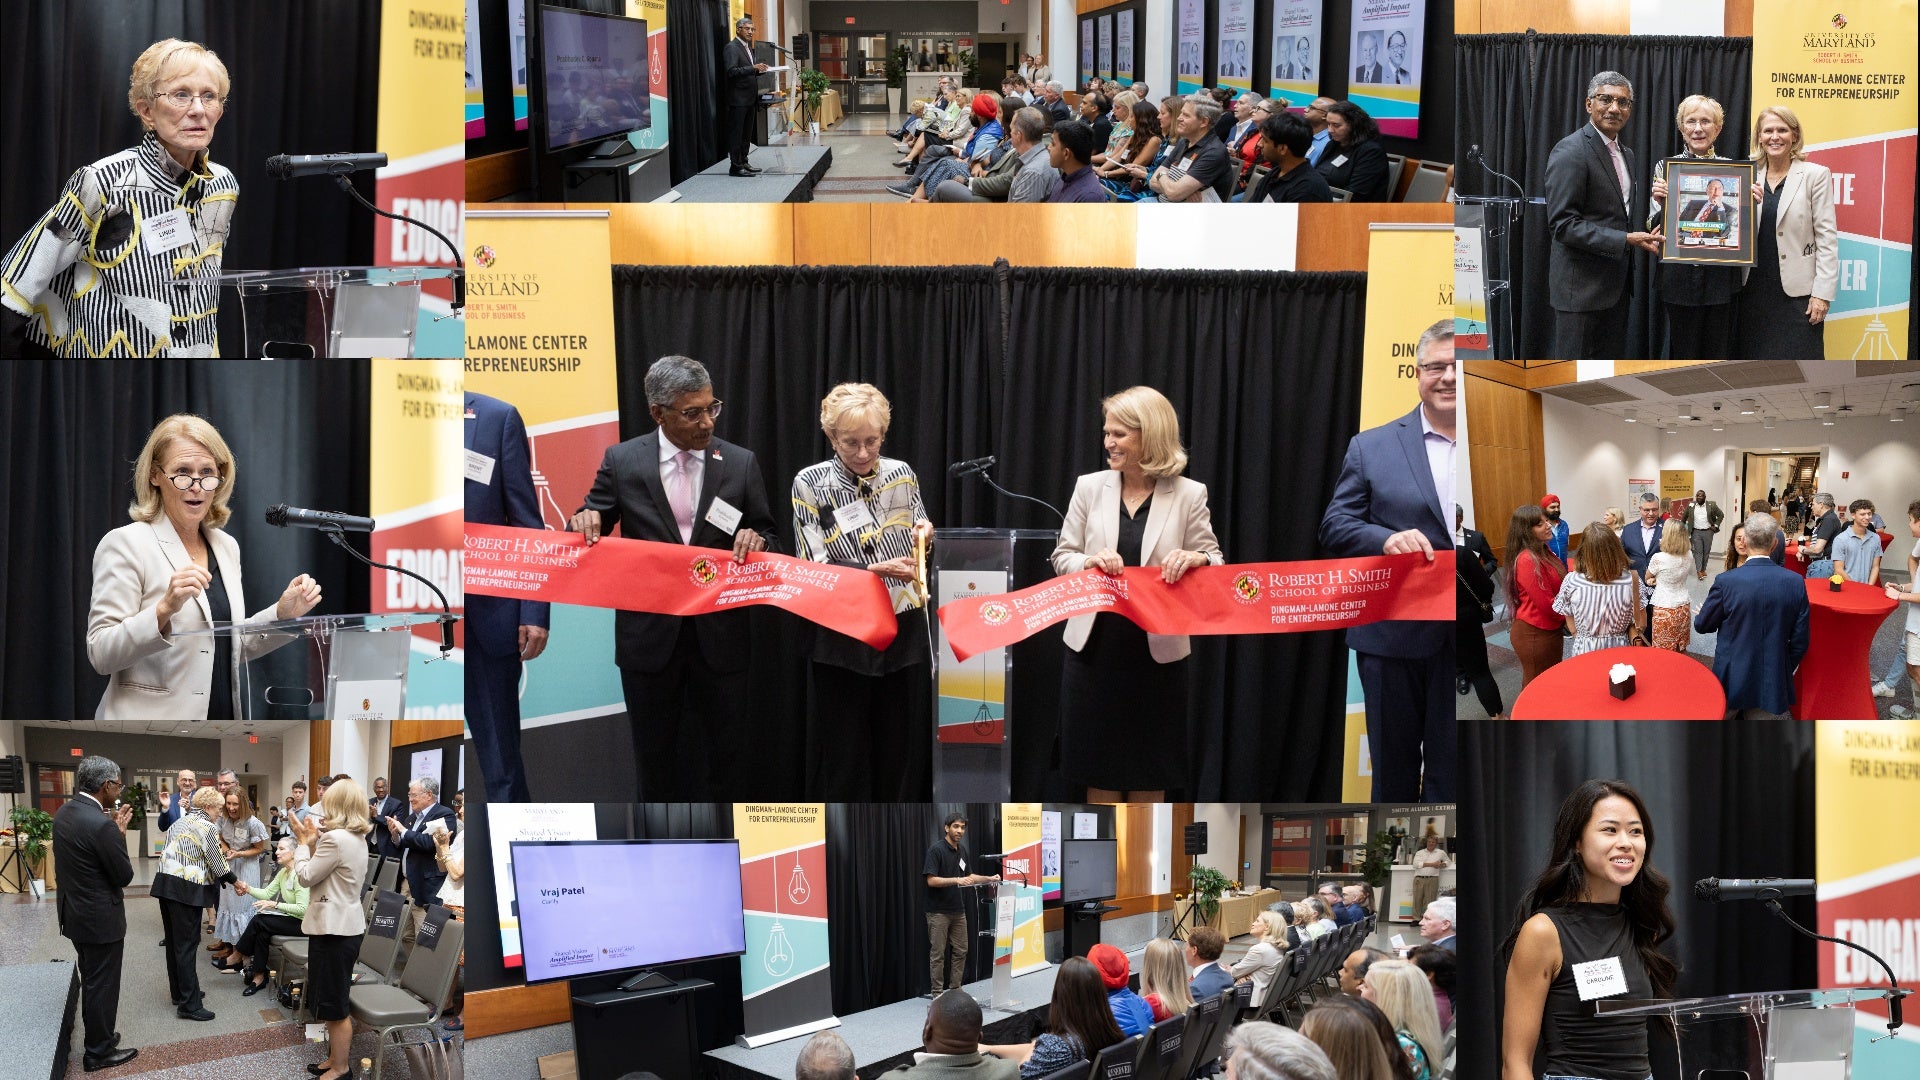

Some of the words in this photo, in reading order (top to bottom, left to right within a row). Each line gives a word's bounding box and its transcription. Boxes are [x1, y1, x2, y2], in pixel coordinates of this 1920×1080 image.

[1362, 4, 1389, 15] Amplified
[1390, 3, 1410, 12] Impact
[1803, 38, 1875, 48] MARYLAND
[1771, 73, 1862, 84] DINGMAN-LAMONE
[1866, 74, 1905, 84] CENTER
[1776, 88, 1794, 98] FOR
[1799, 88, 1900, 99] ENTREPRENEURSHIP
[1838, 260, 1867, 290] ER
[532, 335, 588, 350] CENTER
[1392, 343, 1418, 357] DIN
[1398, 364, 1418, 378] FO
[402, 400, 420, 417] FOR
[514, 539, 531, 553] H.
[533, 539, 581, 558] SMITH
[504, 553, 520, 562] OF
[523, 555, 578, 568] BUSINESS
[521, 571, 549, 582] CENTER
[727, 561, 773, 576] ROBERT
[774, 561, 790, 573] H.
[793, 565, 840, 583] SMITH
[1268, 573, 1325, 587] ROBERT
[1328, 570, 1347, 584] H.
[1349, 568, 1392, 583] SMITH
[466, 576, 541, 591] ENTREPRENEURSHIP
[725, 574, 762, 585] SCHOOL
[780, 573, 834, 591] BUSINESS
[720, 585, 773, 597] DINGMAN-LAMONE
[774, 584, 802, 595] CENTER
[1011, 584, 1066, 609] ROBERT
[1067, 577, 1090, 588] H.
[1089, 573, 1128, 591] SMITH
[1270, 587, 1318, 598] SCHOOL
[1322, 586, 1337, 595] OF
[1342, 581, 1390, 594] BUSINESS
[728, 592, 792, 603] ENTREPRENEURSHIP
[1018, 595, 1064, 616] SCHOOL
[1067, 586, 1081, 596] OF
[1085, 583, 1129, 600] BUSINESS
[1024, 597, 1089, 625] DINGMAN-LAMONE
[1090, 593, 1117, 603] CENTER
[1271, 603, 1338, 614] DINGMAN-LAMONE
[1341, 600, 1367, 610] CENTER
[1026, 619, 1041, 630] FOR
[1040, 601, 1114, 625] ENTREPRENEURSHIP
[1271, 615, 1286, 624] FOR
[1288, 610, 1360, 623] ENTREPRENEURSHIP
[1850, 758, 1870, 776] FOR
[745, 805, 797, 814] DINGMAN-LAMONE
[1006, 859, 1029, 874] EDUCATE
[541, 888, 559, 897] Vraj
[561, 887, 585, 895] Patel
[550, 954, 575, 963] Amplified
[1161, 1037, 1180, 1050] RESERVED
[1107, 1066, 1131, 1078] RESERVED
